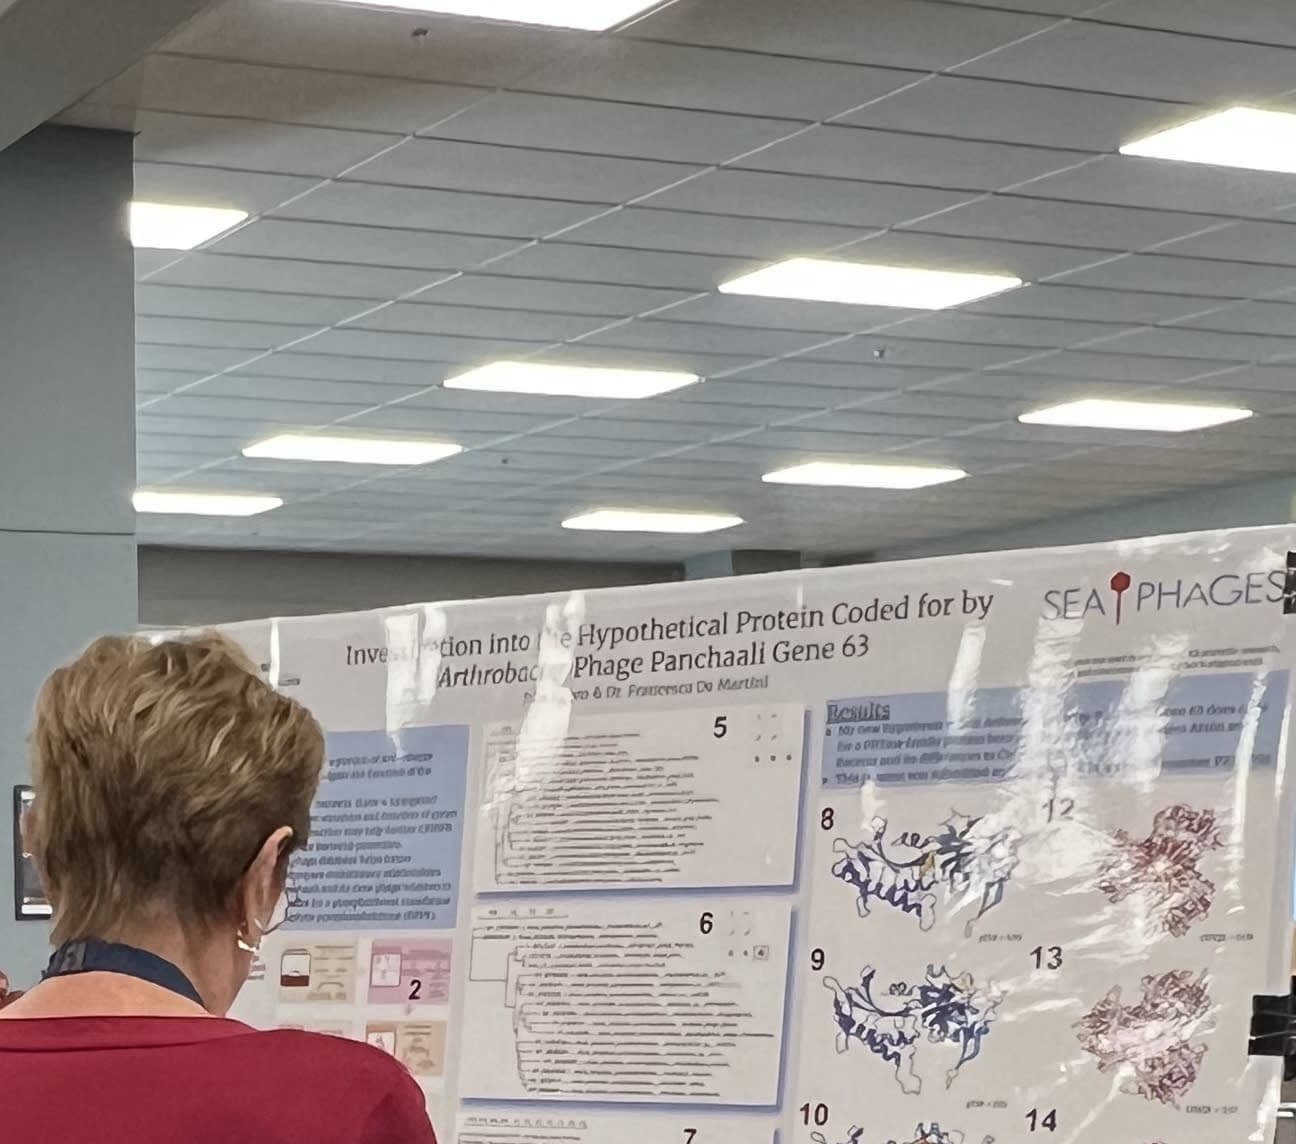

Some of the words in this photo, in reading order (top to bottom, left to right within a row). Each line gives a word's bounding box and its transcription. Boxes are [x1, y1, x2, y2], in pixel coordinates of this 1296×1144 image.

[1041, 588, 1106, 620] SEA
[1136, 570, 1286, 612] PHAGES
[489, 633, 531, 655] into
[577, 611, 728, 651] Hypothetical
[736, 606, 824, 635] Protein
[832, 595, 908, 626] Coded
[918, 594, 954, 619] for
[962, 590, 994, 621] by
[574, 653, 644, 681] Phage
[651, 639, 766, 673] Panchaali
[772, 638, 835, 664] Gene
[841, 634, 870, 659] 63
[713, 716, 728, 739] 5
[820, 807, 835, 830] 8
[699, 911, 714, 934] 6
[810, 948, 825, 971] 9
[1029, 945, 1064, 970] 13
[408, 979, 422, 1001] 2
[799, 1103, 829, 1126] 10
[1024, 1109, 1058, 1132] 14
